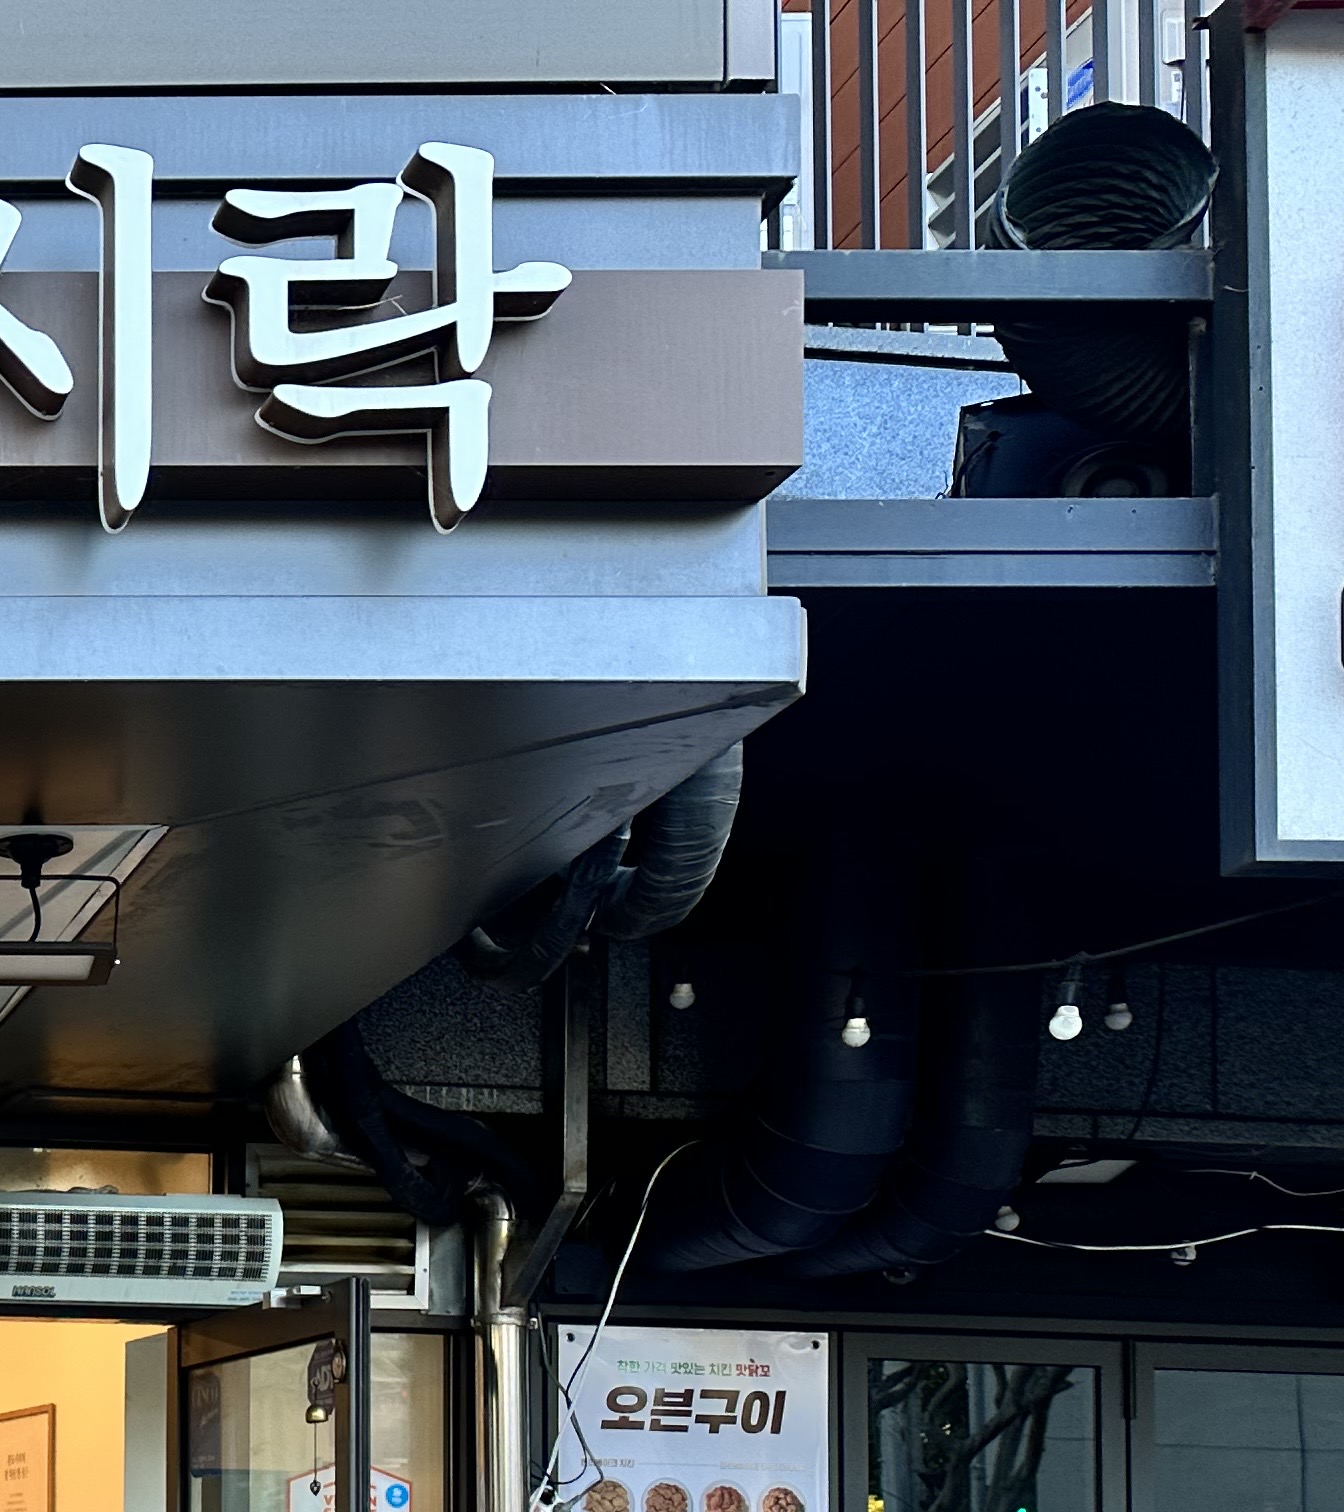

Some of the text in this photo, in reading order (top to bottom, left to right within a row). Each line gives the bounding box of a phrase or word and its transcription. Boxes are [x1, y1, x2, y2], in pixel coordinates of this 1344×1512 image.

[616, 1360, 771, 1378] 착한 가격 맛있는 치킨 맛닭꼬
[600, 1385, 788, 1435] 오븐구이
